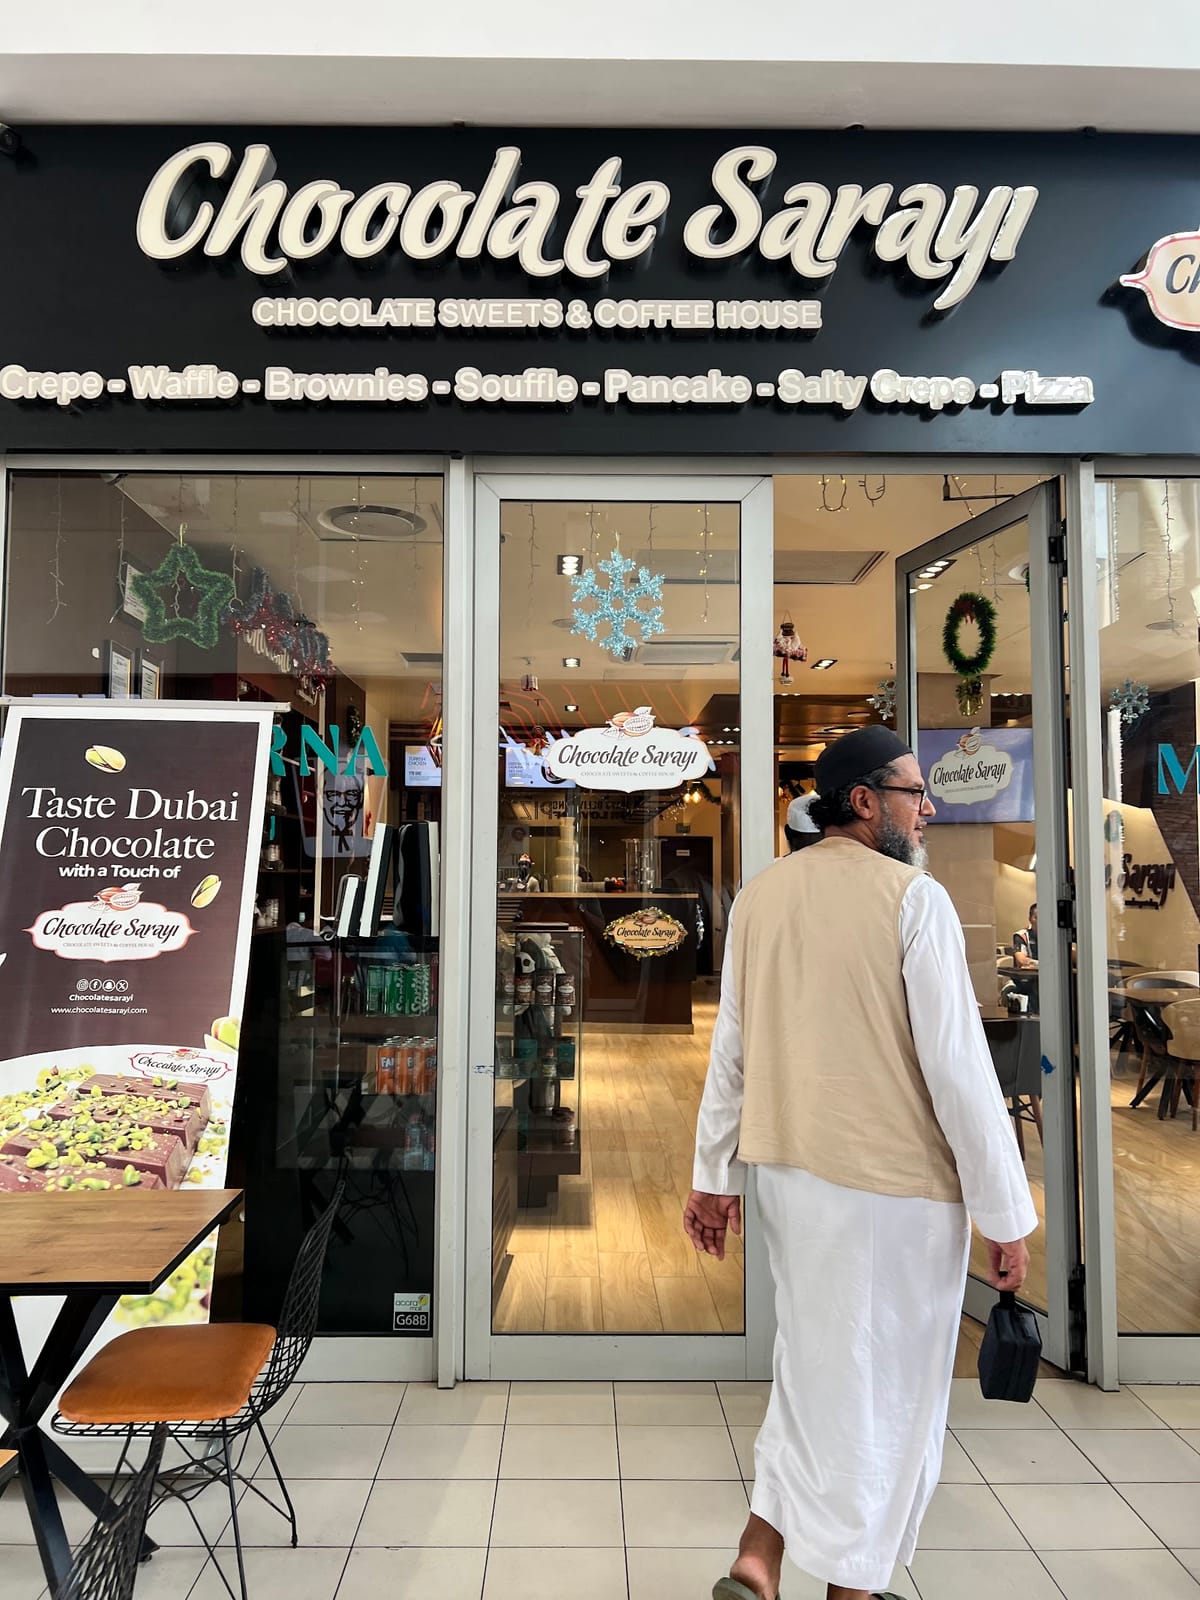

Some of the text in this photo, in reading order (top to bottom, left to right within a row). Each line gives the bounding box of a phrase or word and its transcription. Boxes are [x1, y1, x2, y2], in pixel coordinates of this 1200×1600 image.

[136, 142, 670, 278] Chocolate
[252, 298, 822, 330] CHOCOLATE SWEETS & COFFEE HOUSE
[0, 364, 103, 406] Crepe
[128, 365, 238, 400] Waffle
[265, 367, 428, 402] Brownies
[454, 367, 578, 403] Souffle
[605, 369, 752, 404] Pancake
[777, 369, 867, 410] Salty
[870, 369, 976, 411] Crepe
[1001, 370, 1094, 404] Pizza
[558, 744, 639, 767] Chocolate
[934, 764, 974, 786] Chocolate
[21, 787, 239, 821] Taste Dubai
[35, 826, 215, 859] Chocolate
[58, 864, 181, 878] with a Touch of
[43, 917, 122, 938] Chocolate
[616, 926, 651, 937] Chocolate
[51, 1006, 147, 1015] www.chocolatesarayi.com
[396, 1314, 427, 1326] G68B
